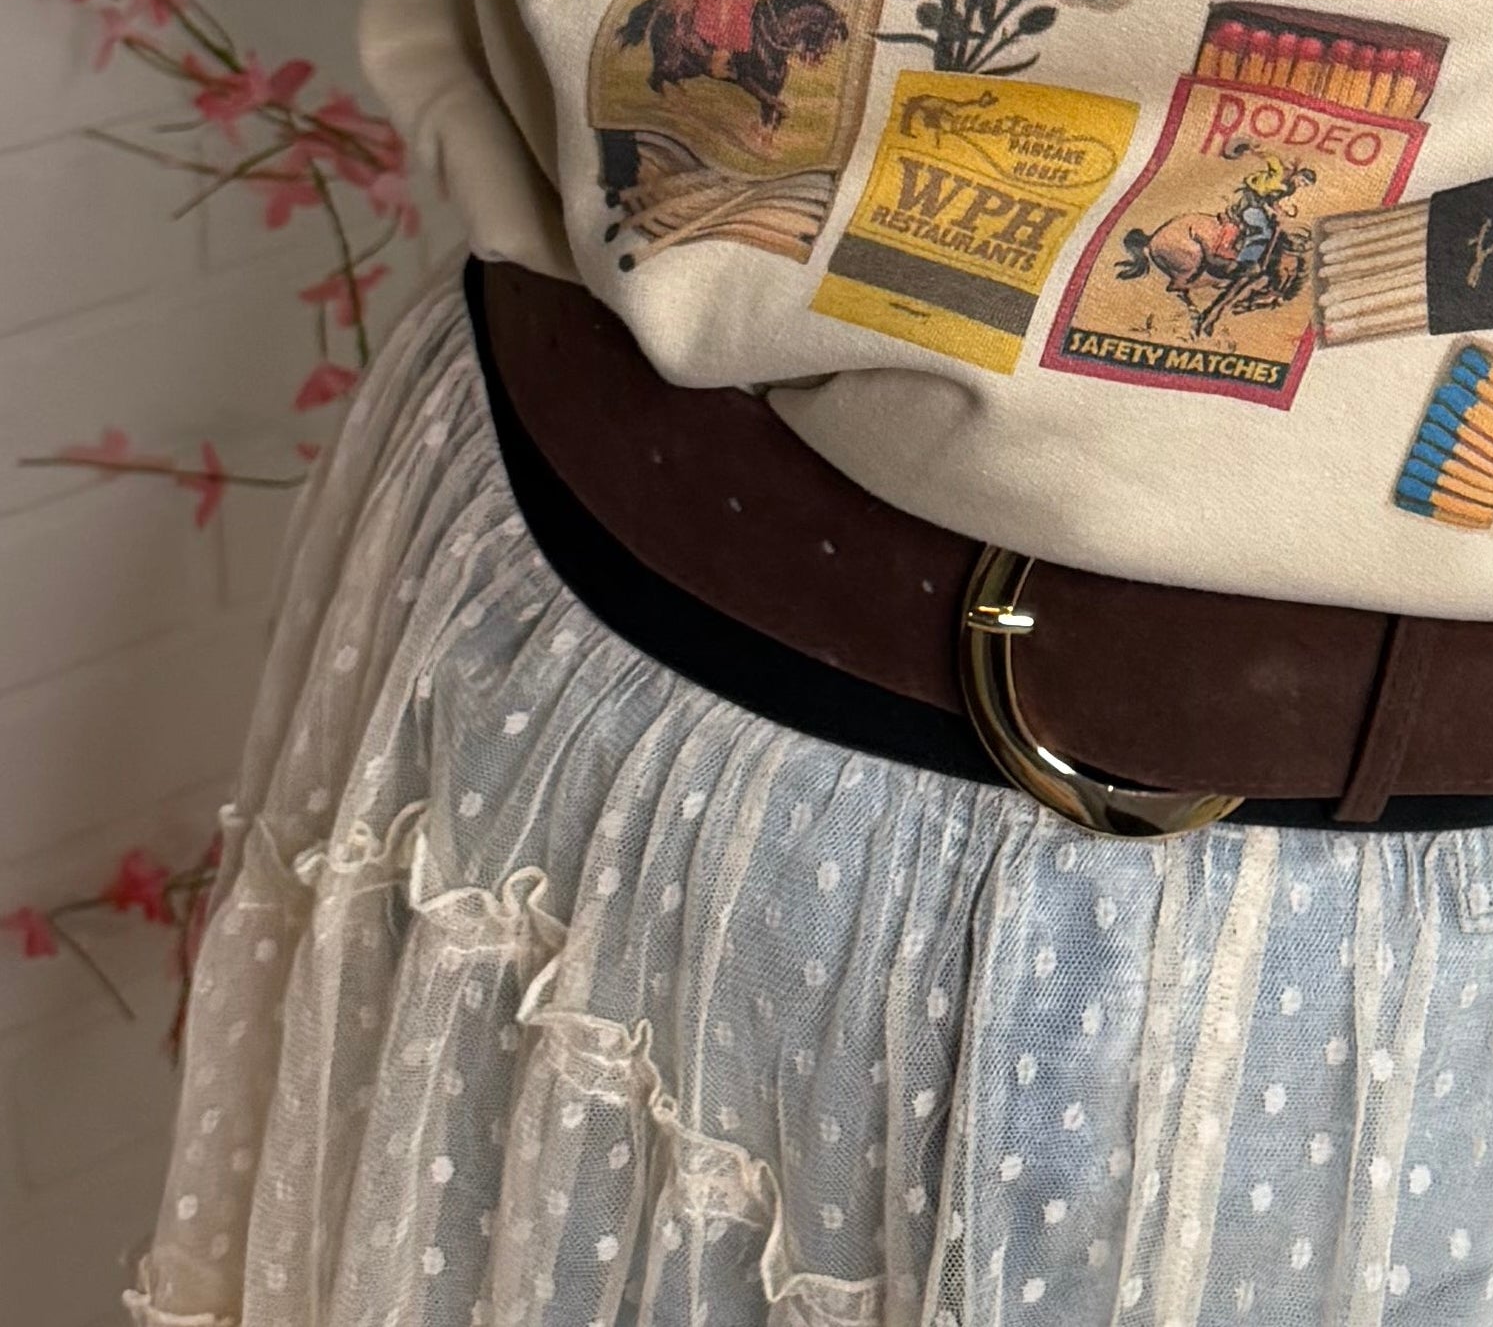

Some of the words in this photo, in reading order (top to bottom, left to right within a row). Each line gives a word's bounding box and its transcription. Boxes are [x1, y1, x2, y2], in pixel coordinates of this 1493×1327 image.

[1200, 92, 1382, 167] RODEO
[870, 205, 1038, 273] RESTAURANTS
[898, 156, 1067, 252] WPH
[1067, 330, 1163, 369] SAFETY
[1165, 346, 1282, 385] MATCHES
